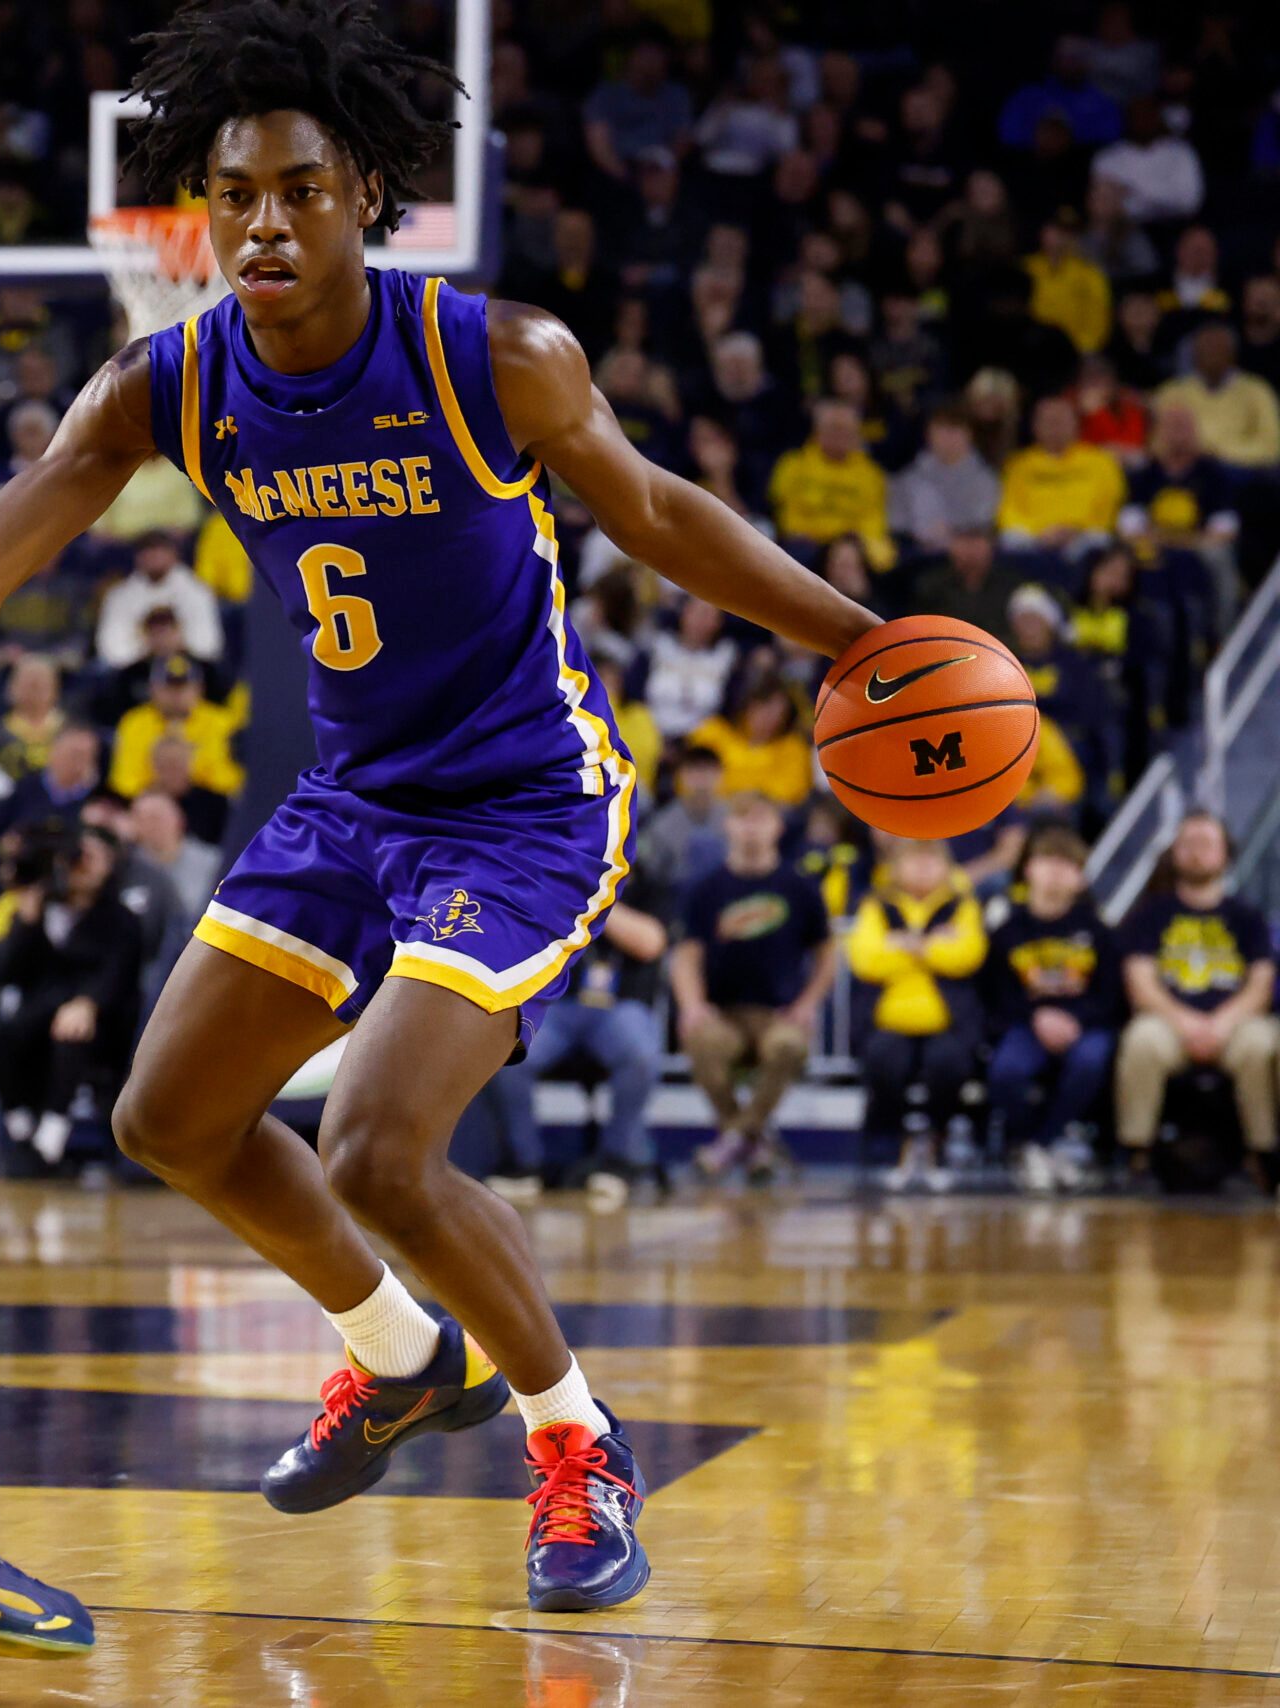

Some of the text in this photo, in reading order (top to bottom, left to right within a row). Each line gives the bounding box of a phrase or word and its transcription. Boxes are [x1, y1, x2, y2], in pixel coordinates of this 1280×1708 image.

[373, 411, 428, 429] SLC
[296, 543, 383, 671] 6
[909, 731, 967, 776] M
